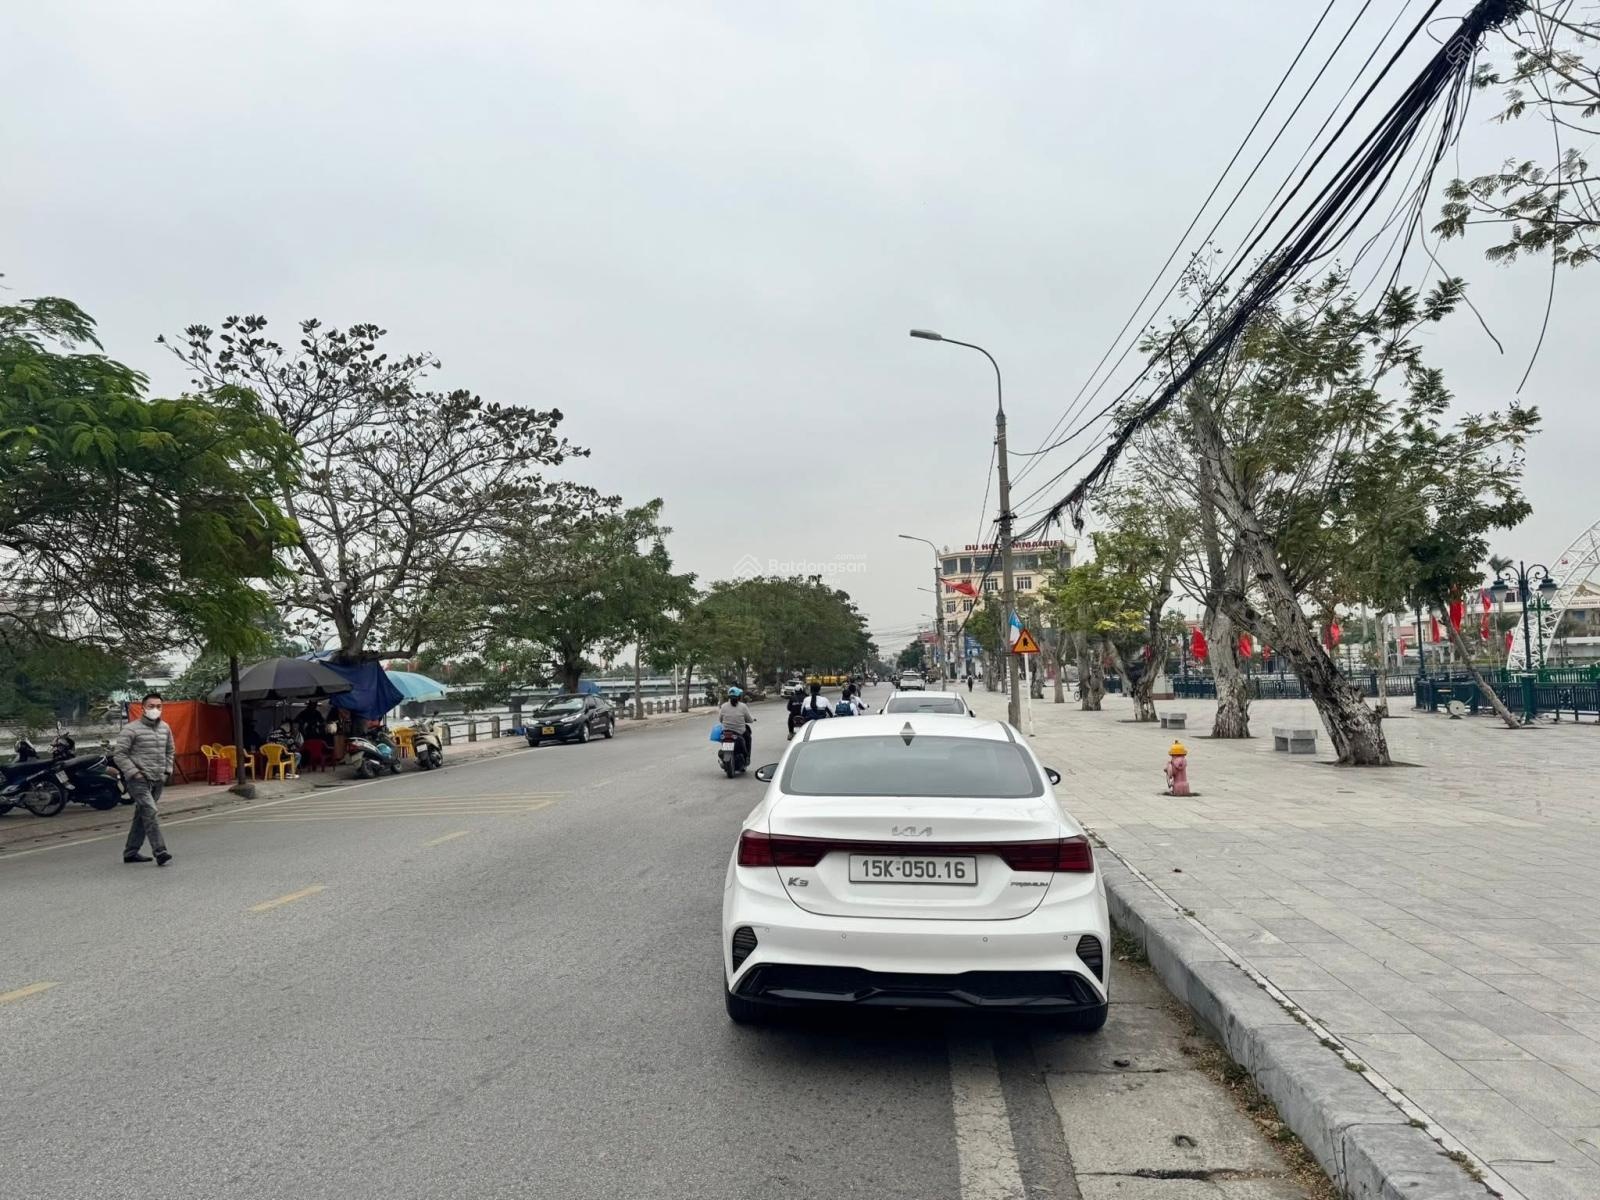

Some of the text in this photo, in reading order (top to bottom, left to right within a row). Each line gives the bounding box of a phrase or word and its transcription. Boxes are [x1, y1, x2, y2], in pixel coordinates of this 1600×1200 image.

[891, 825, 933, 837] KIA
[862, 858, 967, 880] 15K-050.16
[787, 876, 809, 887] K3
